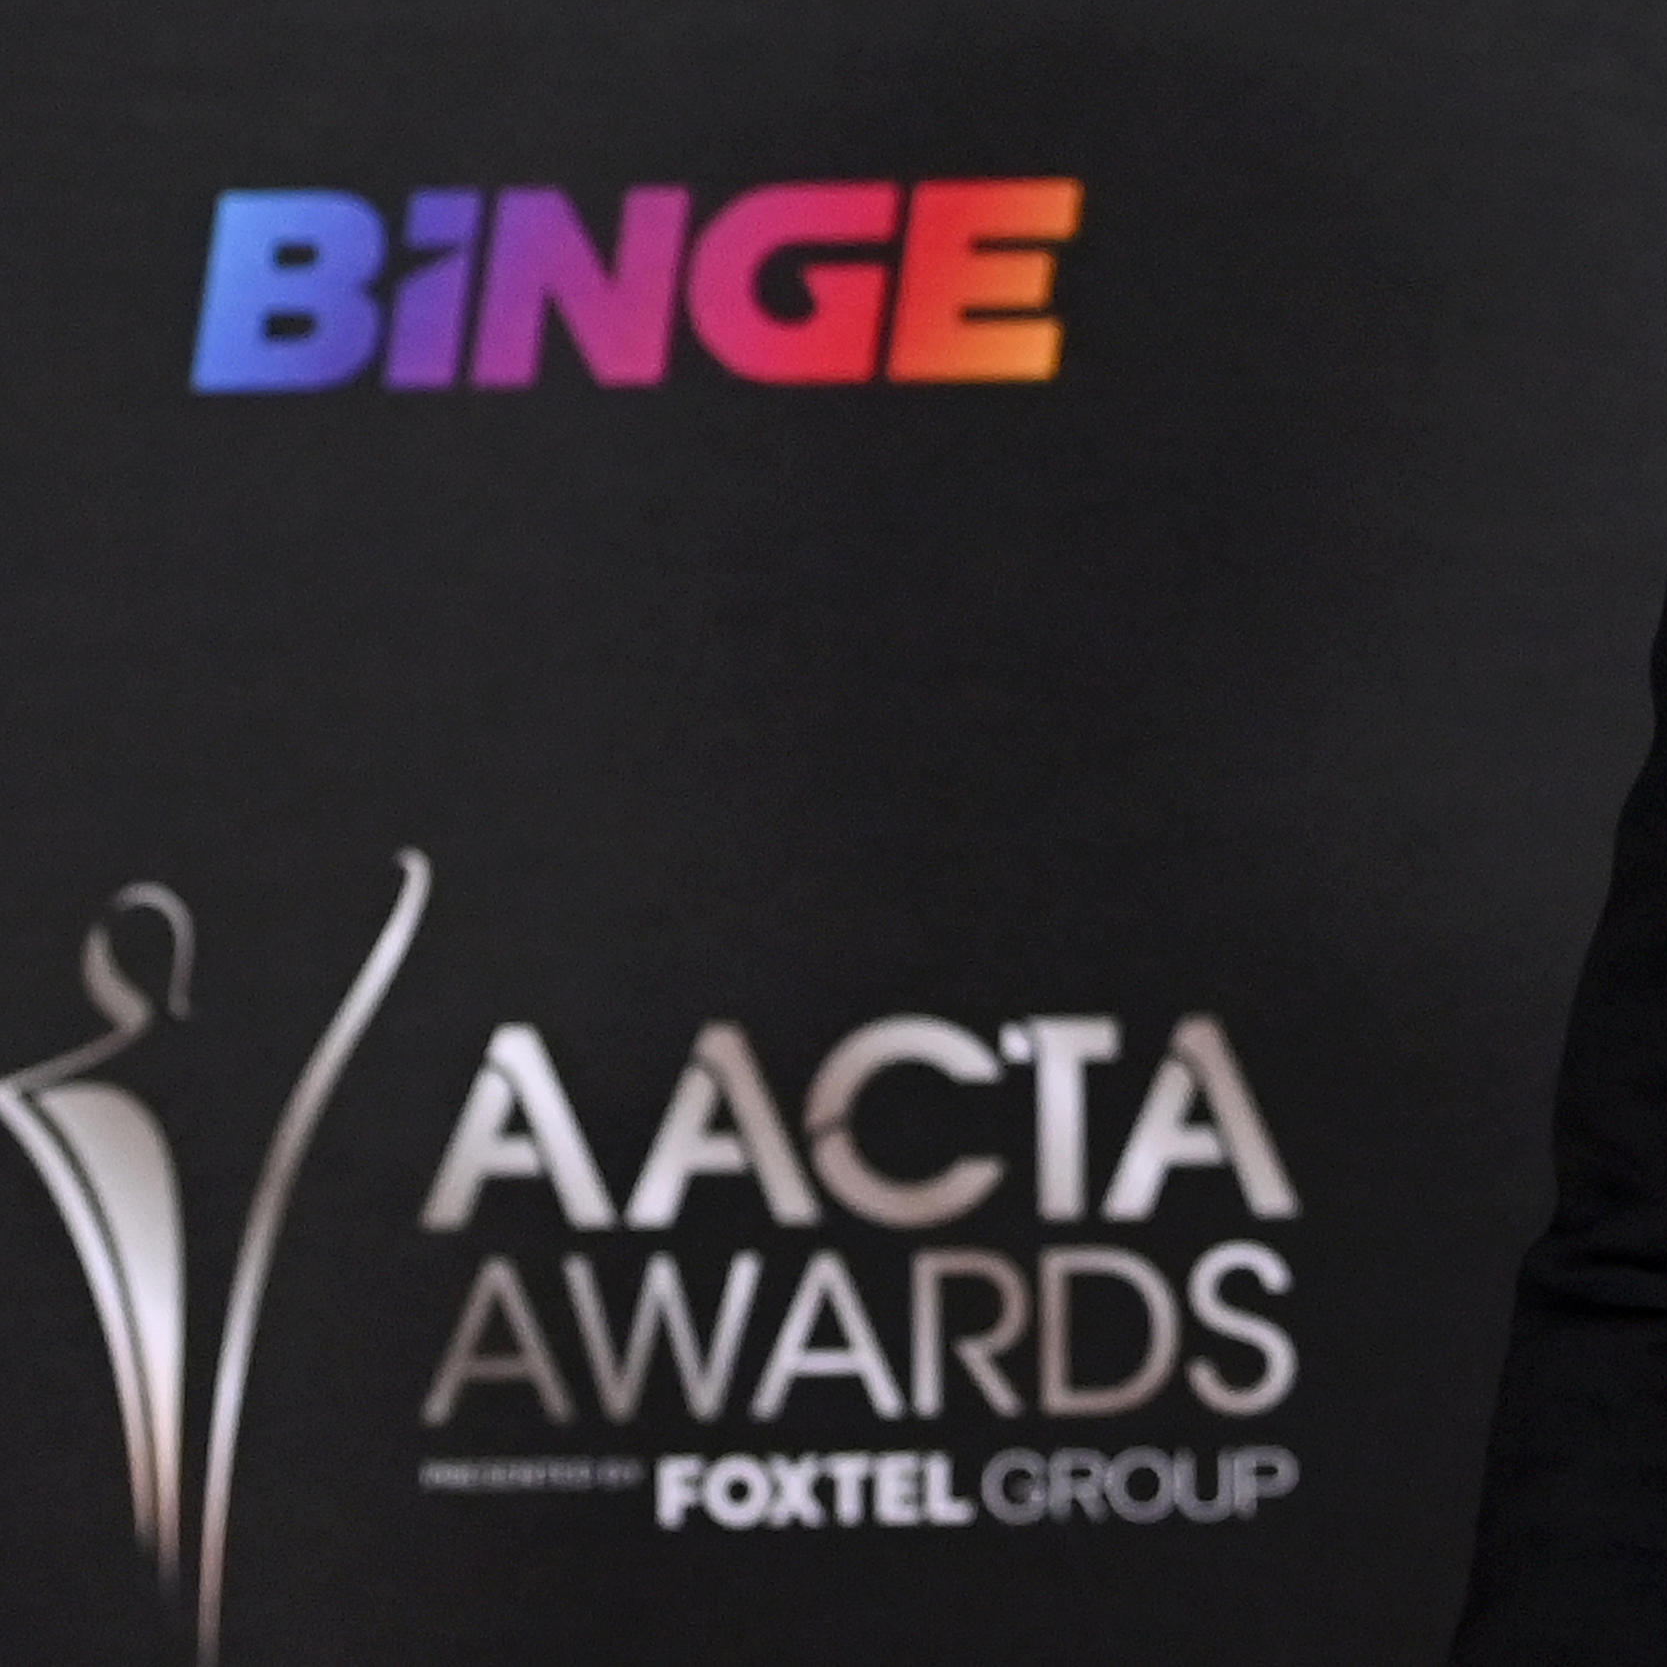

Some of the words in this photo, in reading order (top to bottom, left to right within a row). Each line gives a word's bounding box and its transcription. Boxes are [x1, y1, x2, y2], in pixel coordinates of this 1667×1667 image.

[422, 1015, 1299, 1230] AACTA
[423, 1240, 1298, 1424] AWARDS
[655, 1451, 977, 1530] FOXTEL
[980, 1446, 1300, 1524] GROUP
